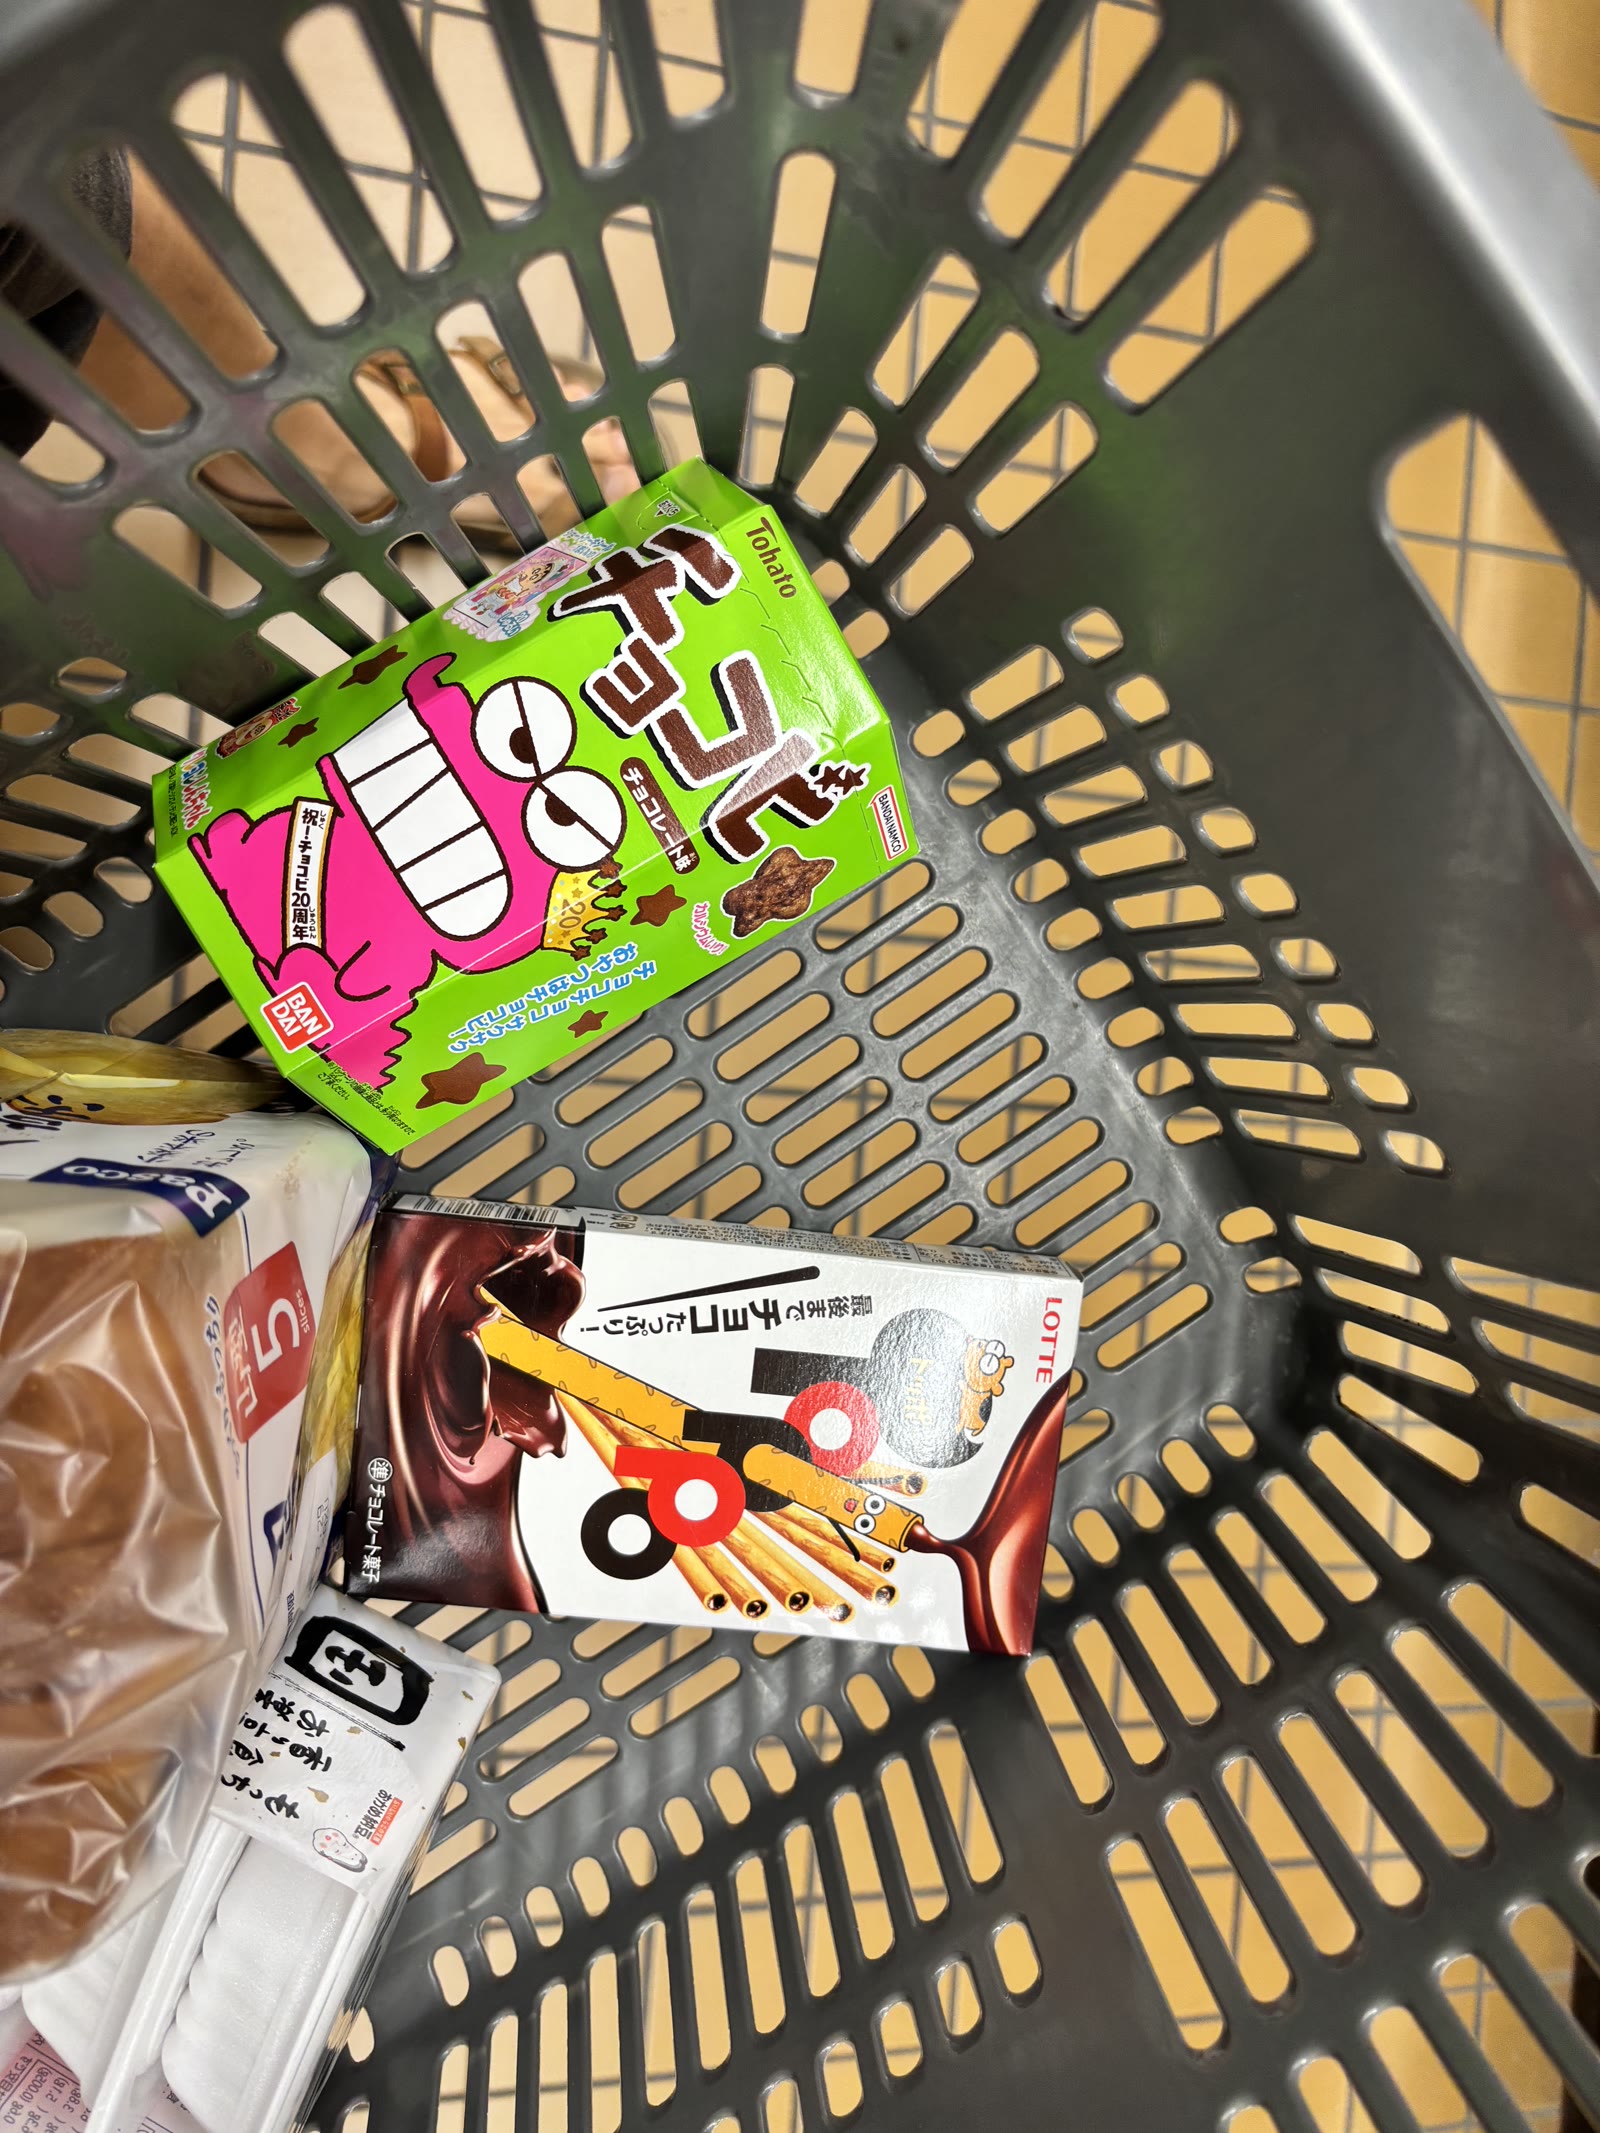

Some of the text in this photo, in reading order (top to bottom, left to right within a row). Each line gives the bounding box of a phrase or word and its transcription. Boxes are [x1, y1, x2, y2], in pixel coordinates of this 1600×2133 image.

[743, 517, 802, 601] Tohato
[558, 528, 864, 859] チョコビ
[622, 764, 691, 871] チョコレート味
[876, 793, 904, 853] BANDAI NAMCO
[270, 1001, 302, 1038] DAI
[286, 992, 322, 1035] BAN
[448, 941, 640, 1042] おやつはチョコビ!
[451, 960, 655, 1054] チョコチョコ サクサク
[63, 1165, 232, 1219] Pasco
[251, 1298, 300, 1373] 5
[296, 1289, 310, 1334] slices
[580, 1294, 870, 1335] 最後までチョコたっぷり!
[1035, 1297, 1060, 1383] LOTTE
[362, 1484, 385, 1582] チョコレート菓子
[284, 1616, 434, 1725] 国
